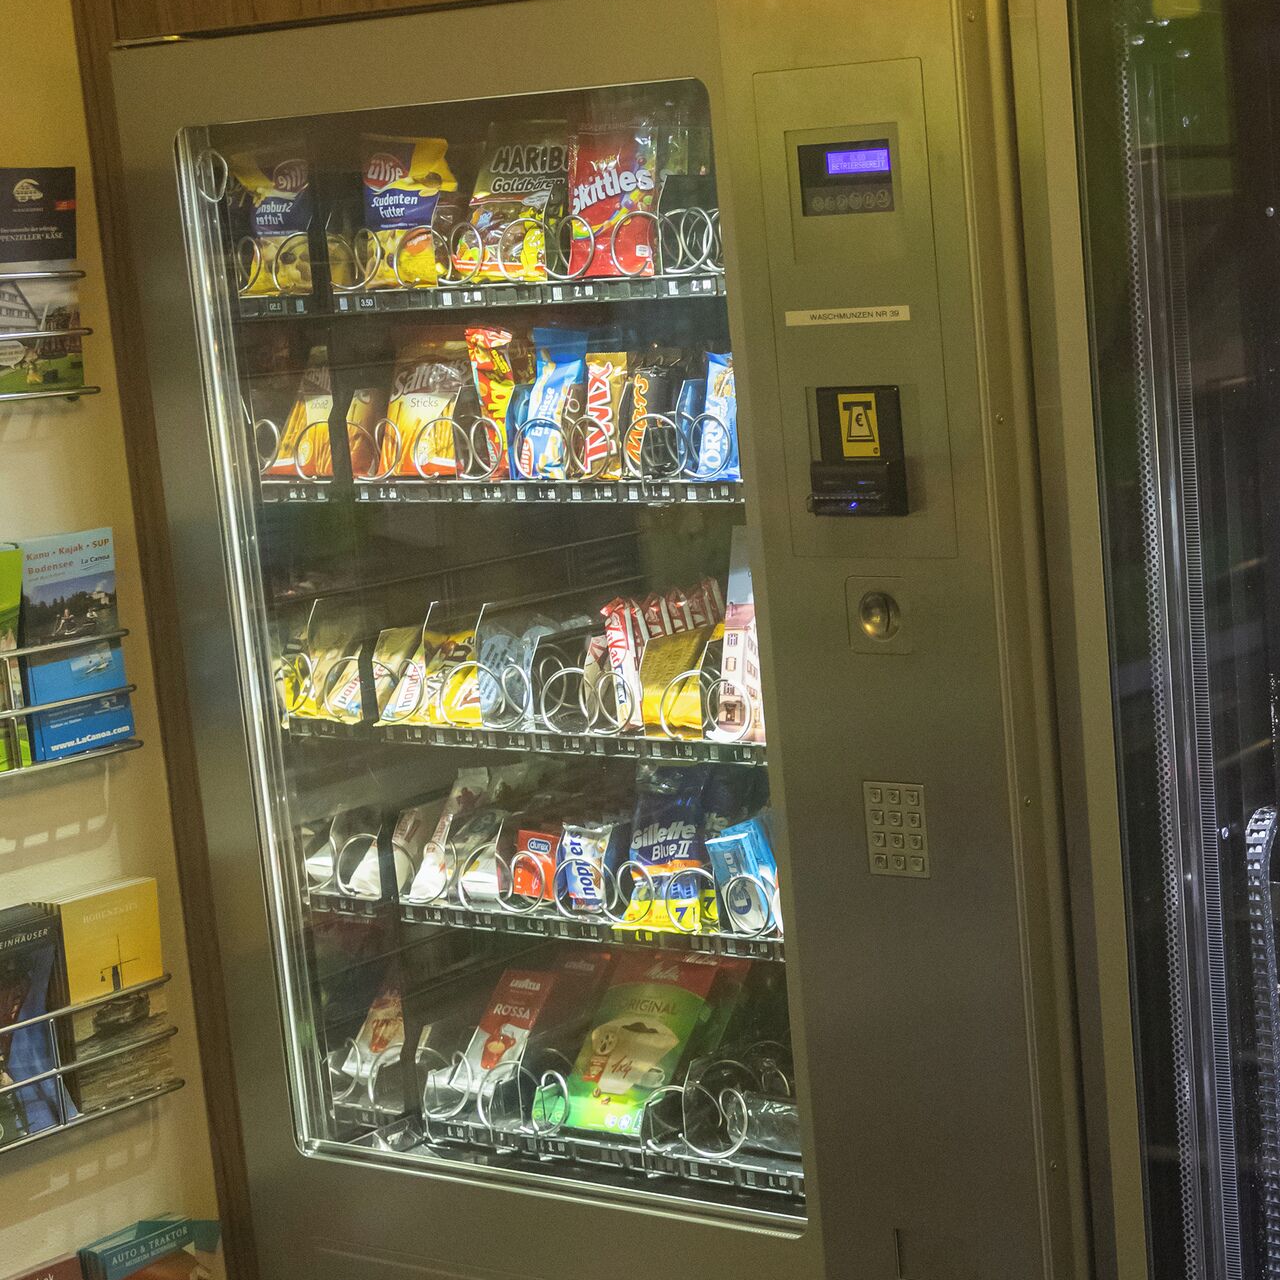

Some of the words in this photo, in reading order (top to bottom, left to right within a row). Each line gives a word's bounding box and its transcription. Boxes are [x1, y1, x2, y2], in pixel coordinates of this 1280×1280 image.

[371, 194, 418, 207] Studenten
[380, 207, 406, 218] Futter
[875, 310, 888, 318] NR
[410, 398, 439, 408] Sticks
[26, 550, 49, 561] Kanu
[58, 542, 84, 555] Kajak
[92, 538, 110, 548] SUP
[27, 559, 74, 575] Bodensee
[631, 821, 697, 850] Gillette
[529, 839, 550, 852] durex
[652, 844, 677, 861] Blue
[677, 840, 693, 858] II
[493, 1004, 531, 1019] ROSSA
[112, 1247, 137, 1265] AUTO
[148, 1226, 188, 1250] TRAKTOR
